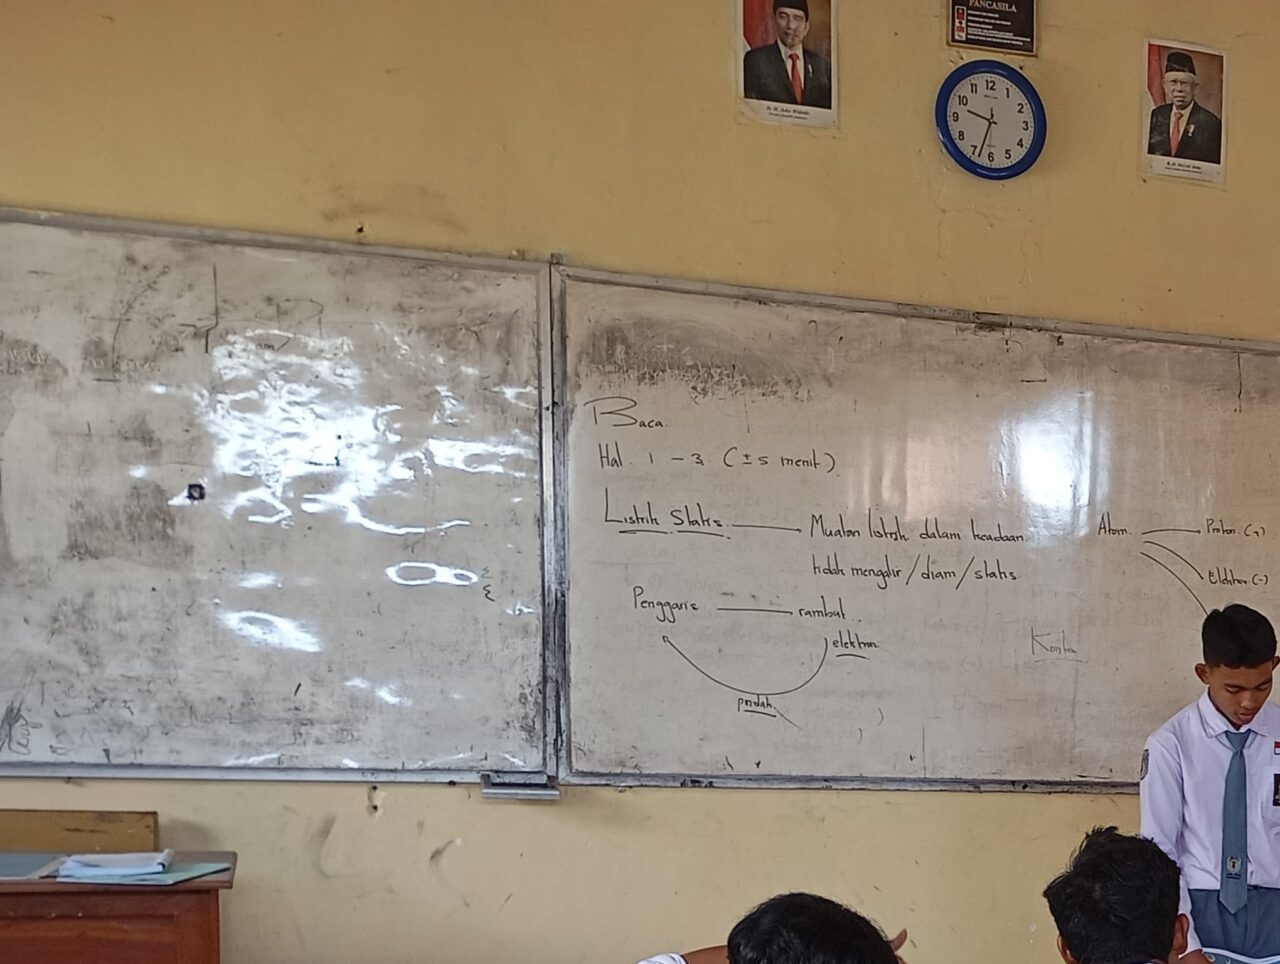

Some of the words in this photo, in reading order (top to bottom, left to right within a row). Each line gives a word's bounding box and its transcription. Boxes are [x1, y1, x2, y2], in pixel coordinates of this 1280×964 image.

[969, 0, 1017, 12] PANCASILA
[970, 83, 978, 94] 11
[985, 79, 996, 91] 12
[1005, 87, 1010, 98] 1
[958, 95, 968, 106] 10
[1017, 103, 1024, 114] 2
[952, 111, 959, 122] 9
[1022, 121, 1029, 131] 3
[958, 130, 965, 141] 8
[1017, 138, 1024, 149] 4
[970, 144, 978, 156] 7
[1004, 149, 1012, 159] 5
[987, 151, 995, 162] 6
[919, 516, 962, 541] dalam
[633, 586, 700, 624] Penggaris
